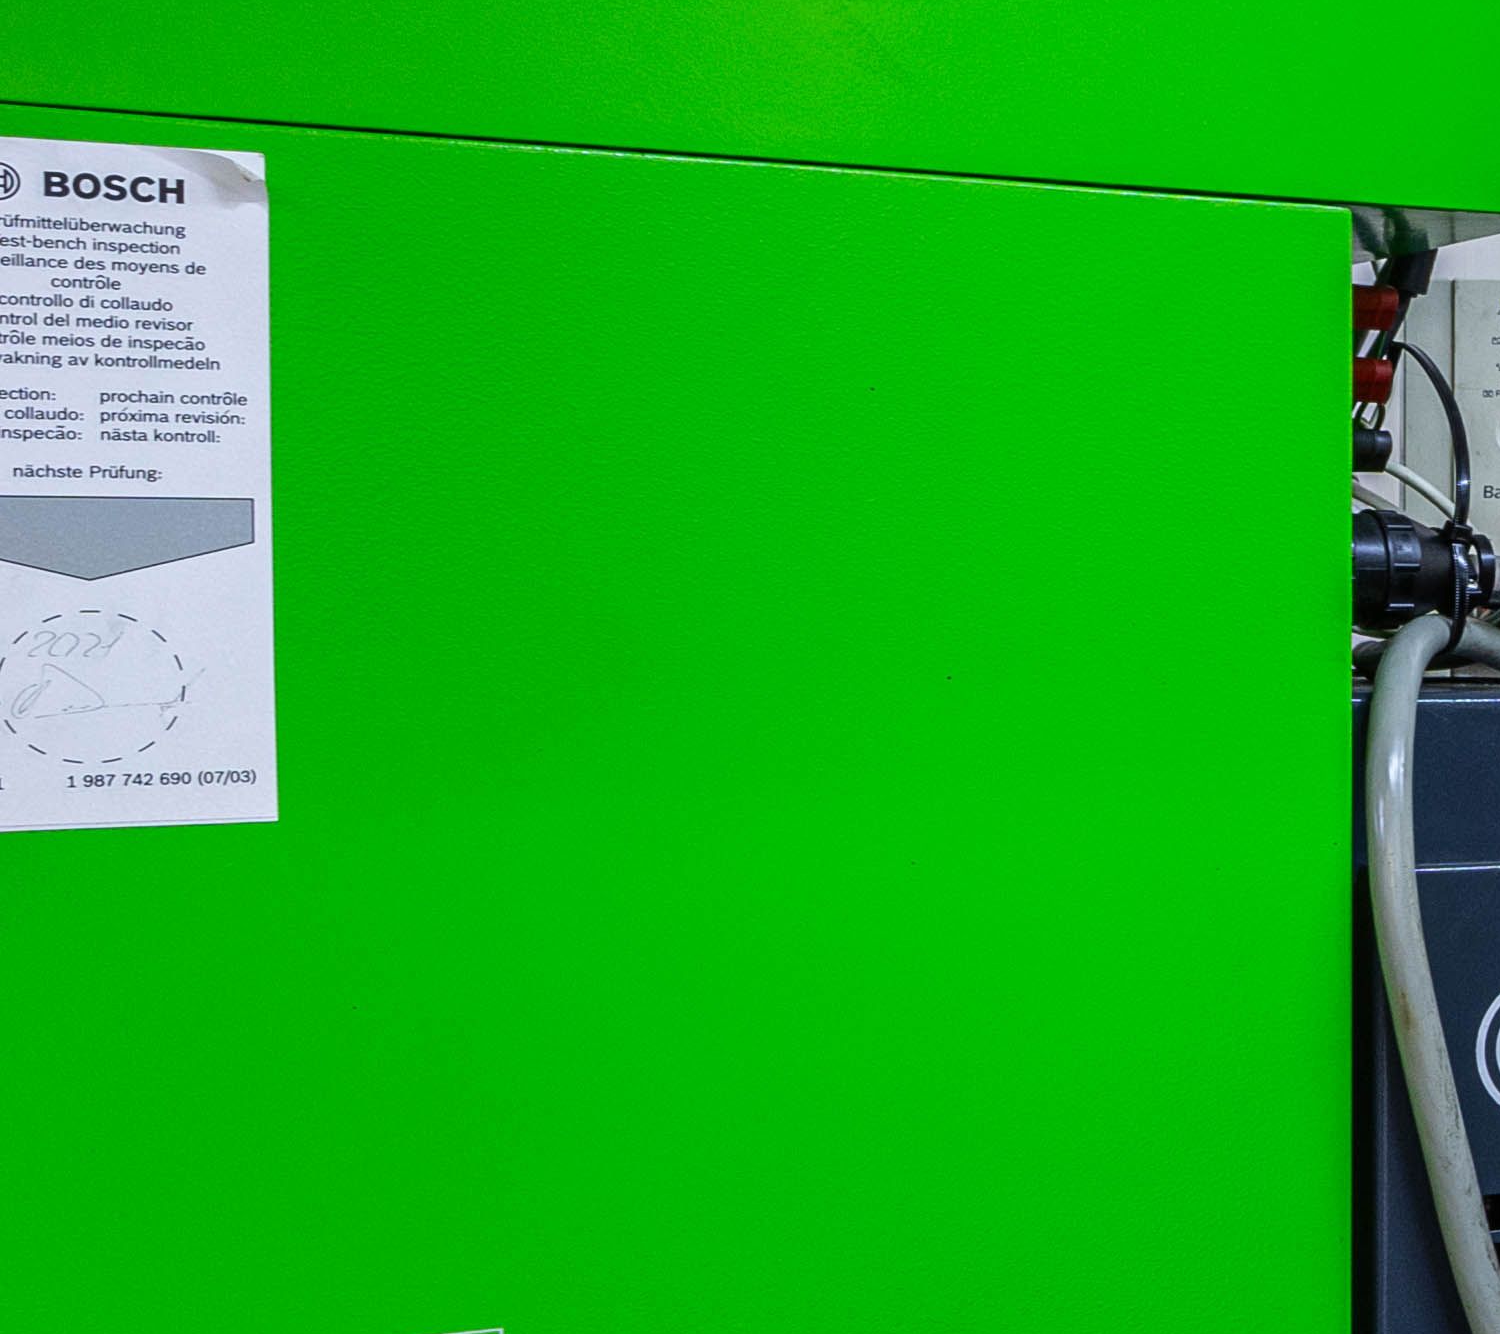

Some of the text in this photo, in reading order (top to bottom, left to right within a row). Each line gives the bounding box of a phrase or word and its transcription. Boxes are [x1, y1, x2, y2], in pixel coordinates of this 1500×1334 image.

[44, 171, 186, 204] BOSCH
[0, 214, 187, 239] üfmittelüberwachung
[0, 234, 181, 255] est-bench inspection
[0, 254, 207, 275] eillance des moyens de
[50, 274, 122, 291] contrôle
[79, 295, 95, 309] di
[100, 296, 174, 312] collaudo
[43, 313, 194, 331] del medio revisor
[42, 333, 207, 352] meios de inspecão
[68, 353, 221, 371] av kontrollmedeln
[0, 388, 248, 407] ection: prochain contrôle
[4, 407, 247, 427] collaudo: próxima revisión:
[100, 428, 221, 444] nästa kontroll:
[12, 465, 163, 482] nächste Prüfung:
[67, 769, 257, 788] 1 987 742 690 (07/03)
